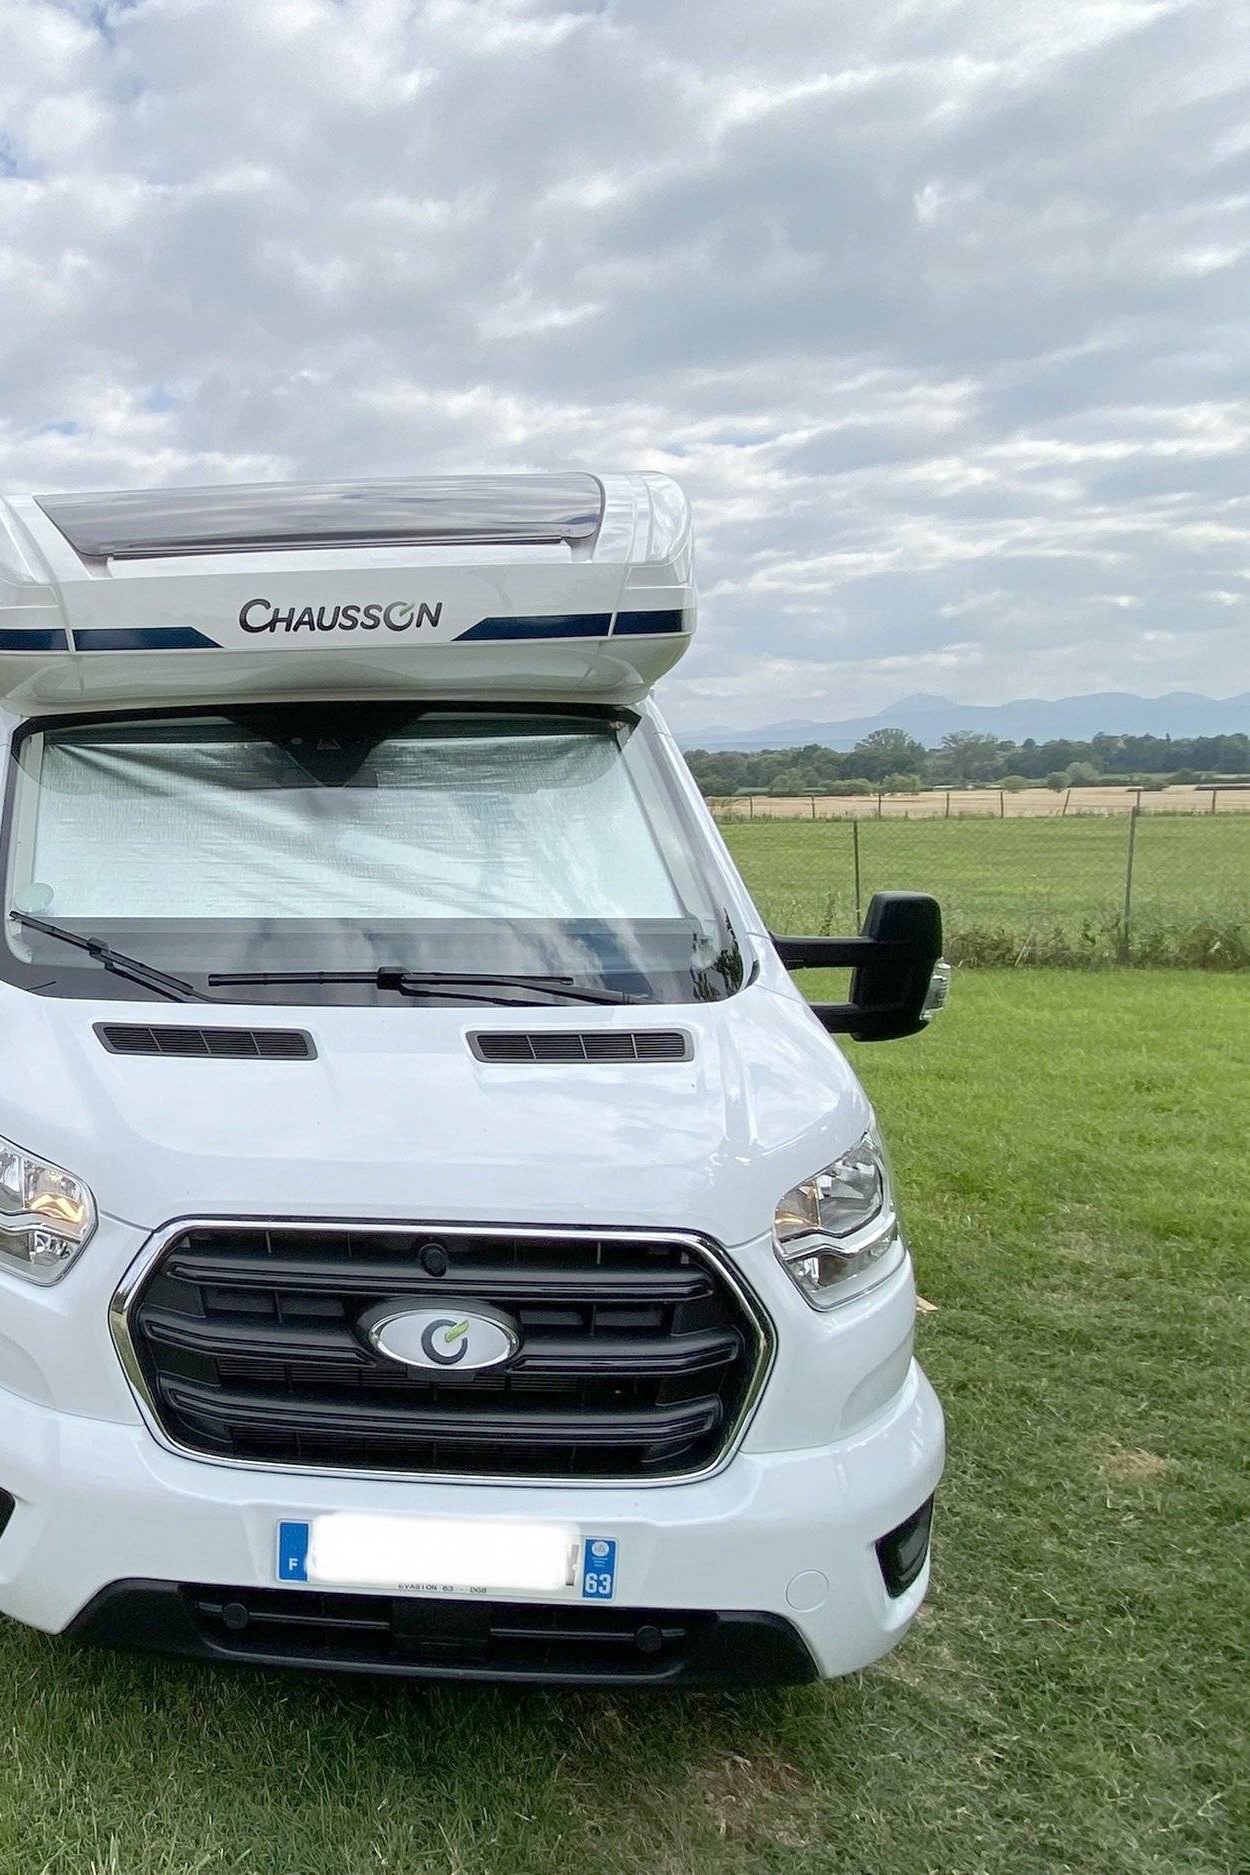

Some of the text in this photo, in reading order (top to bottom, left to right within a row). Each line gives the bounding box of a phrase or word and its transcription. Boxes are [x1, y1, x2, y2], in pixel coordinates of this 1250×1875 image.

[239, 598, 442, 633] CHAUSSON
[288, 1557, 298, 1571] F
[585, 1572, 612, 1594] 63
